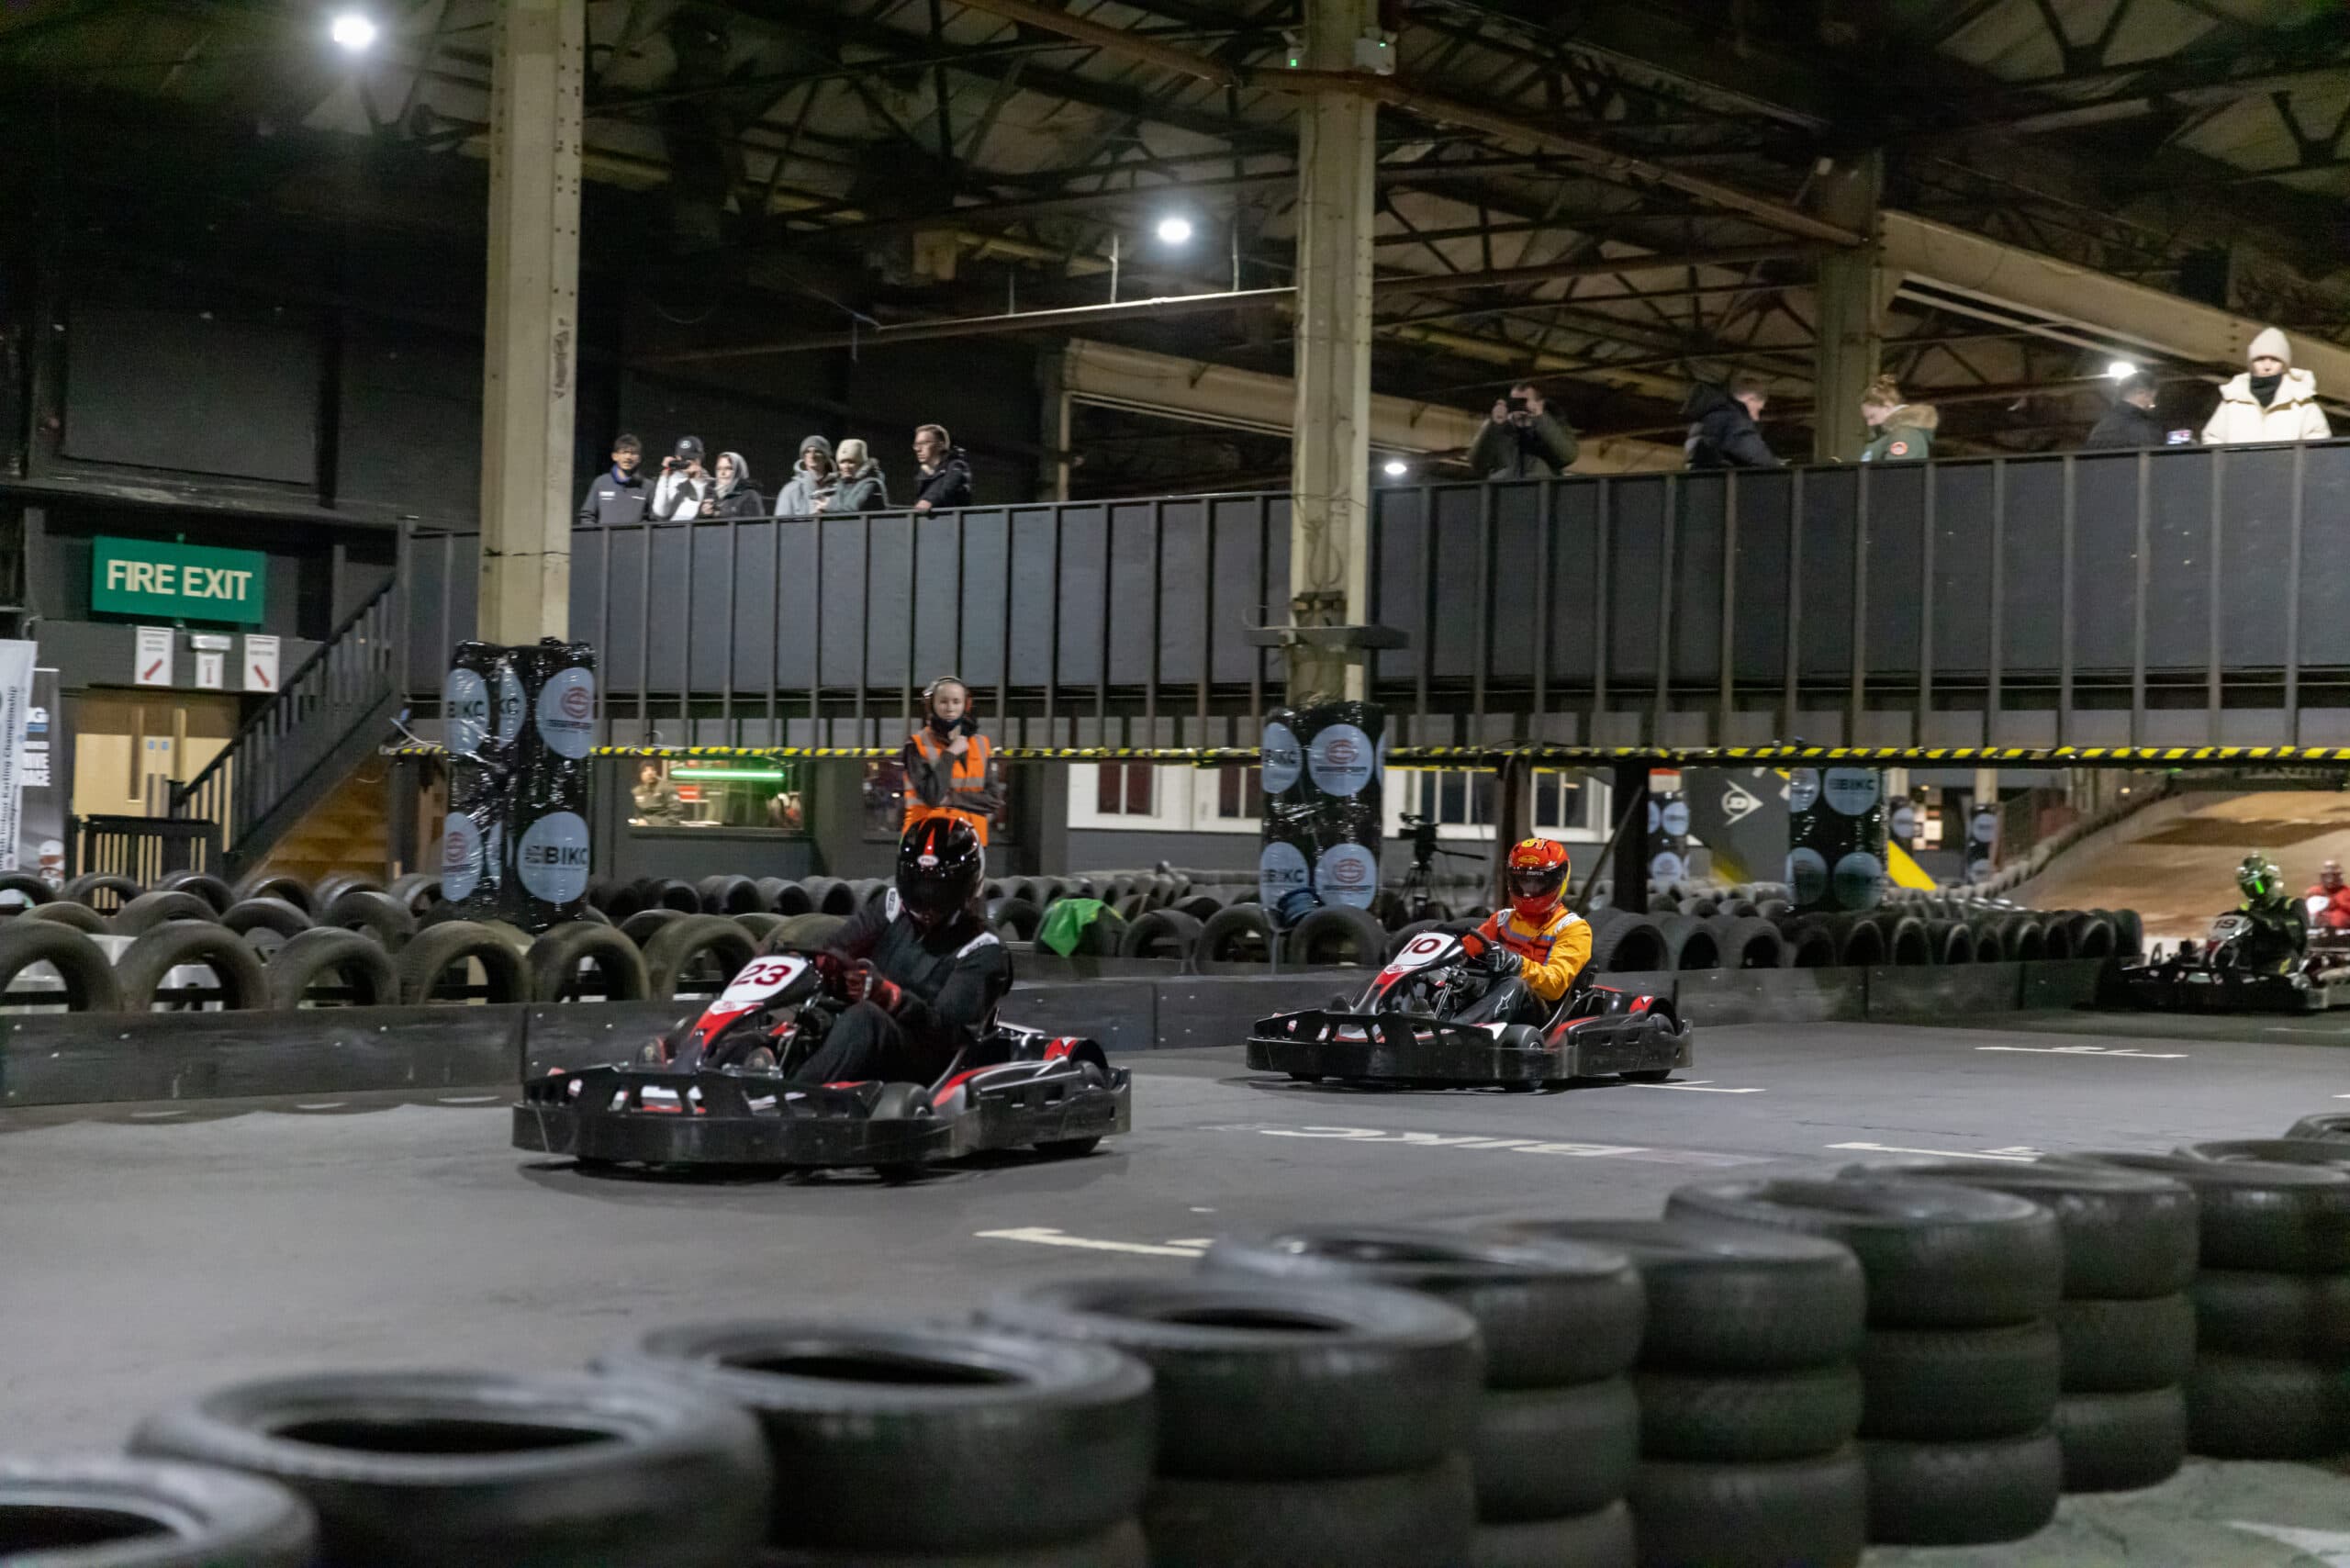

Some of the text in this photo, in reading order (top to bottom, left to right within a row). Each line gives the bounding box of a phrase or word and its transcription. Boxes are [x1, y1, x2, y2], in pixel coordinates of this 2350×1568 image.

[106, 559, 252, 601] FIRE EXIT
[4, 686, 18, 758] Championship
[1, 760, 12, 799] Karting
[1401, 938, 1441, 954] 10
[733, 963, 792, 986] 23
